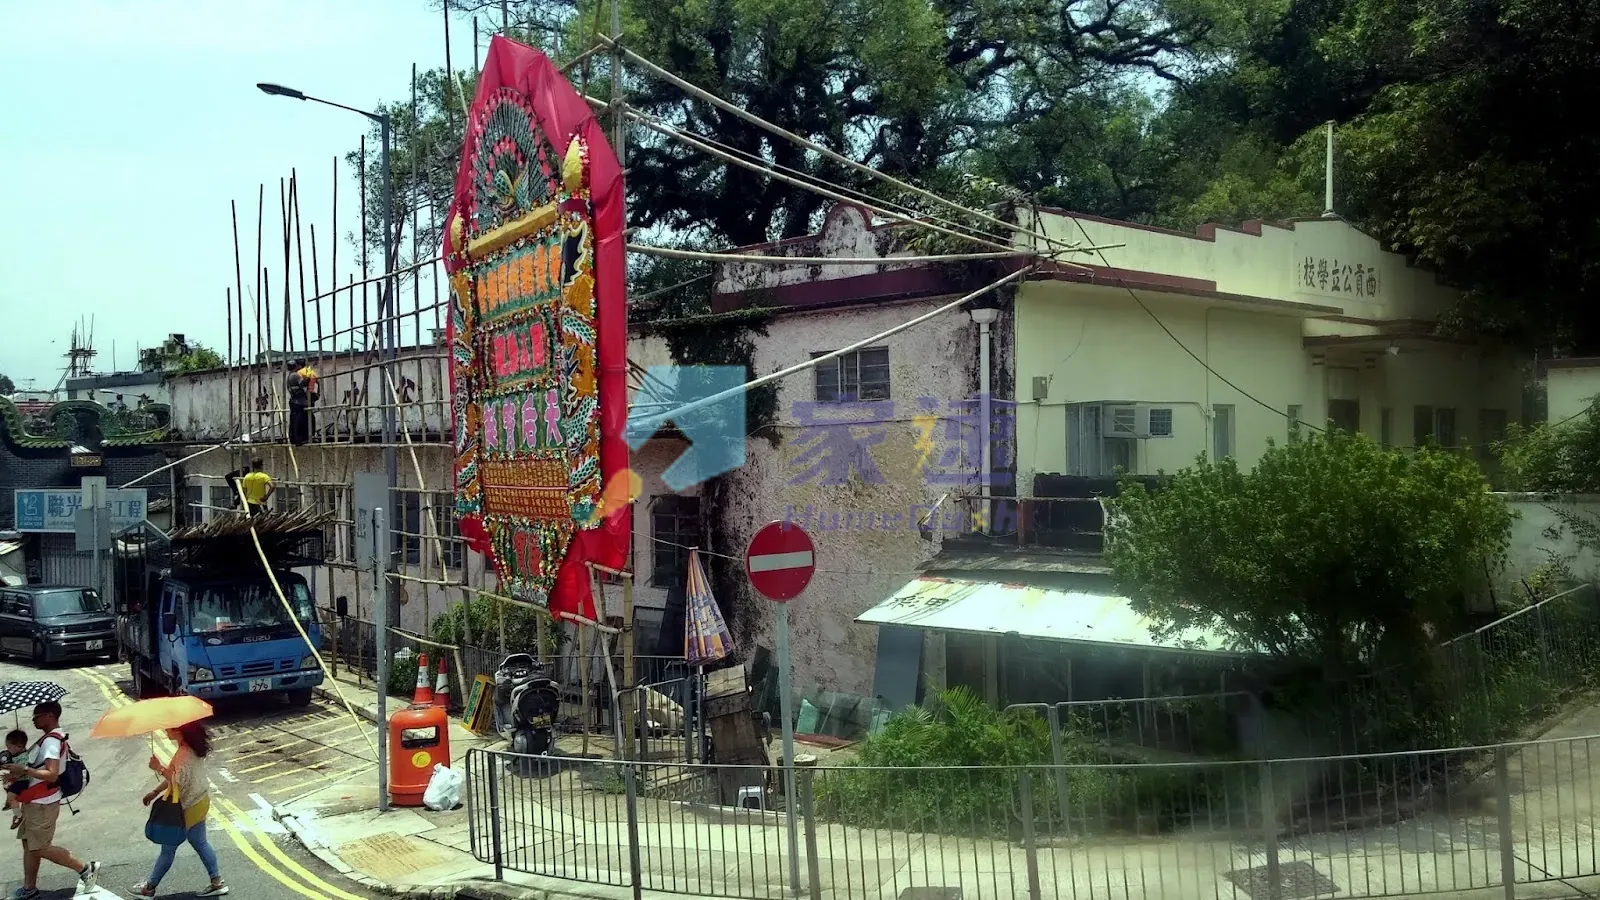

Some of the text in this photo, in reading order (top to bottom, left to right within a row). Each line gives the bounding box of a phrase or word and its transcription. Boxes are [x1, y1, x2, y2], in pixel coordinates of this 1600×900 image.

[1303, 256, 1377, 298] 西貢公立學校
[47, 494, 142, 518] 聯光工程
[243, 634, 271, 643] ISUZU
